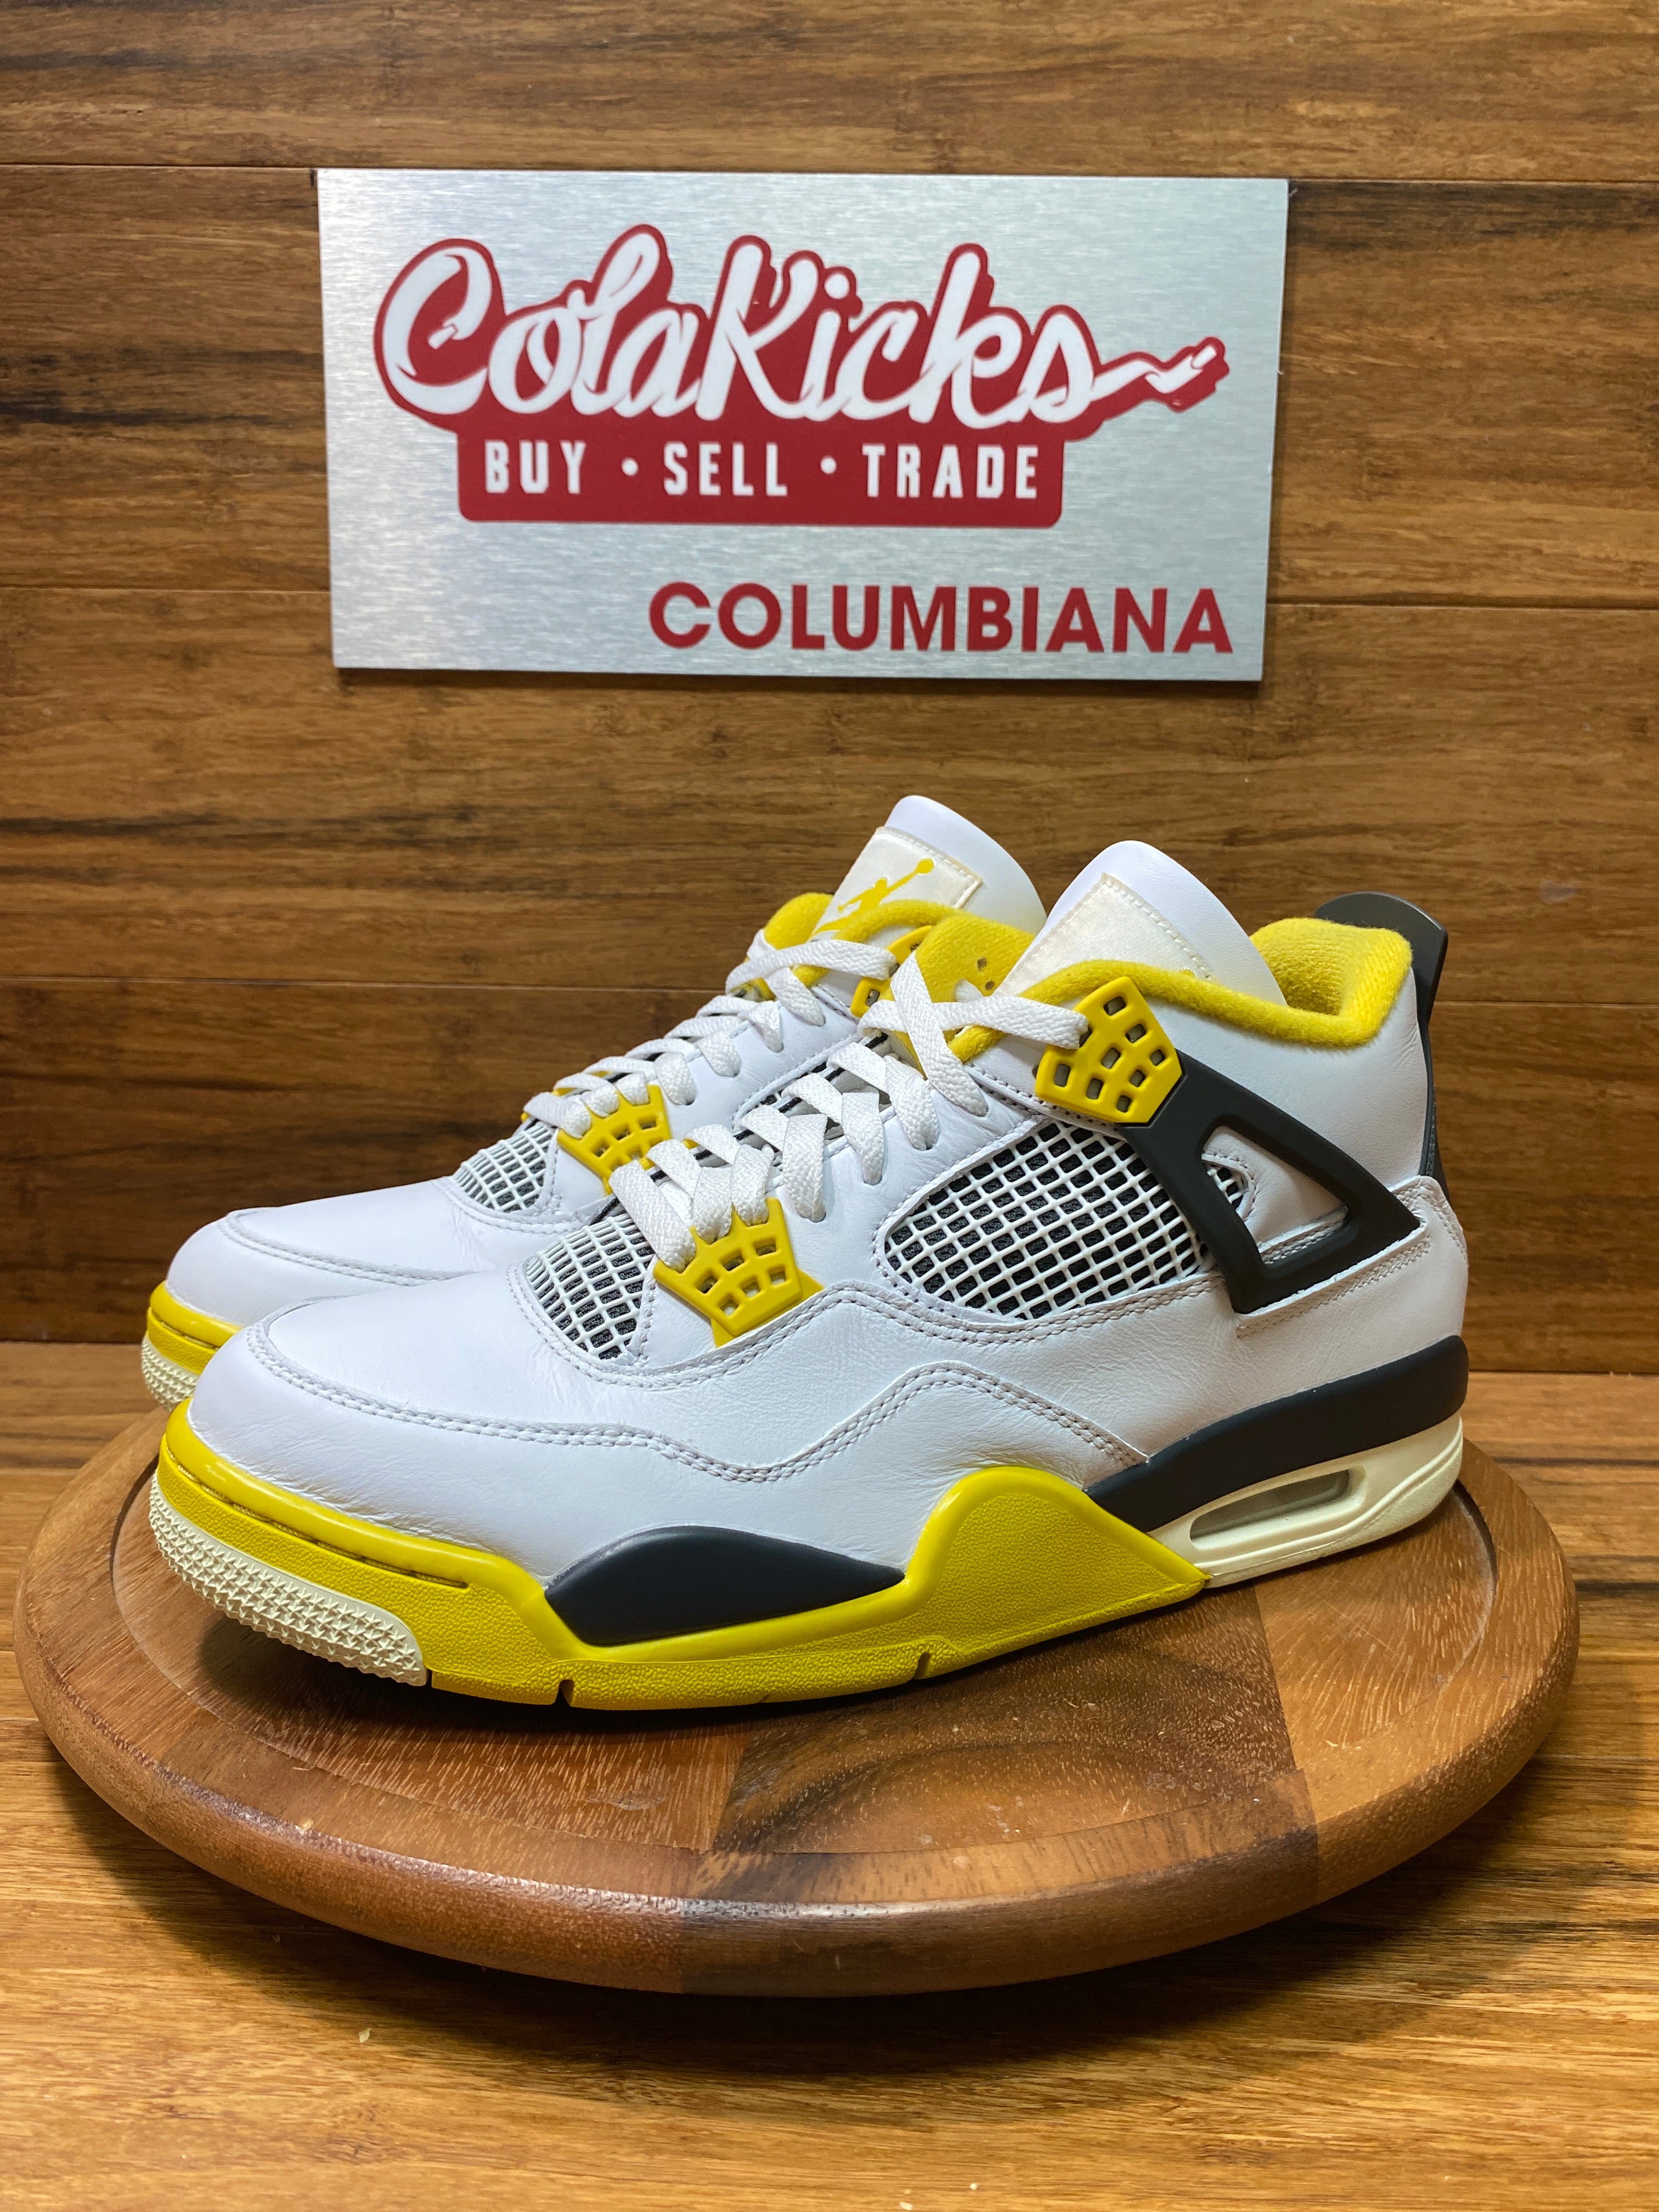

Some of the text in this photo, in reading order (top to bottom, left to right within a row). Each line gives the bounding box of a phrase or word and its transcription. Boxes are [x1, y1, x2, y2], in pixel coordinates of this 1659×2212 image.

[381, 229, 1218, 430] ColaKicks
[484, 441, 1039, 499] BUY SELL TRADE
[648, 582, 1233, 654] COLUMBIANA
